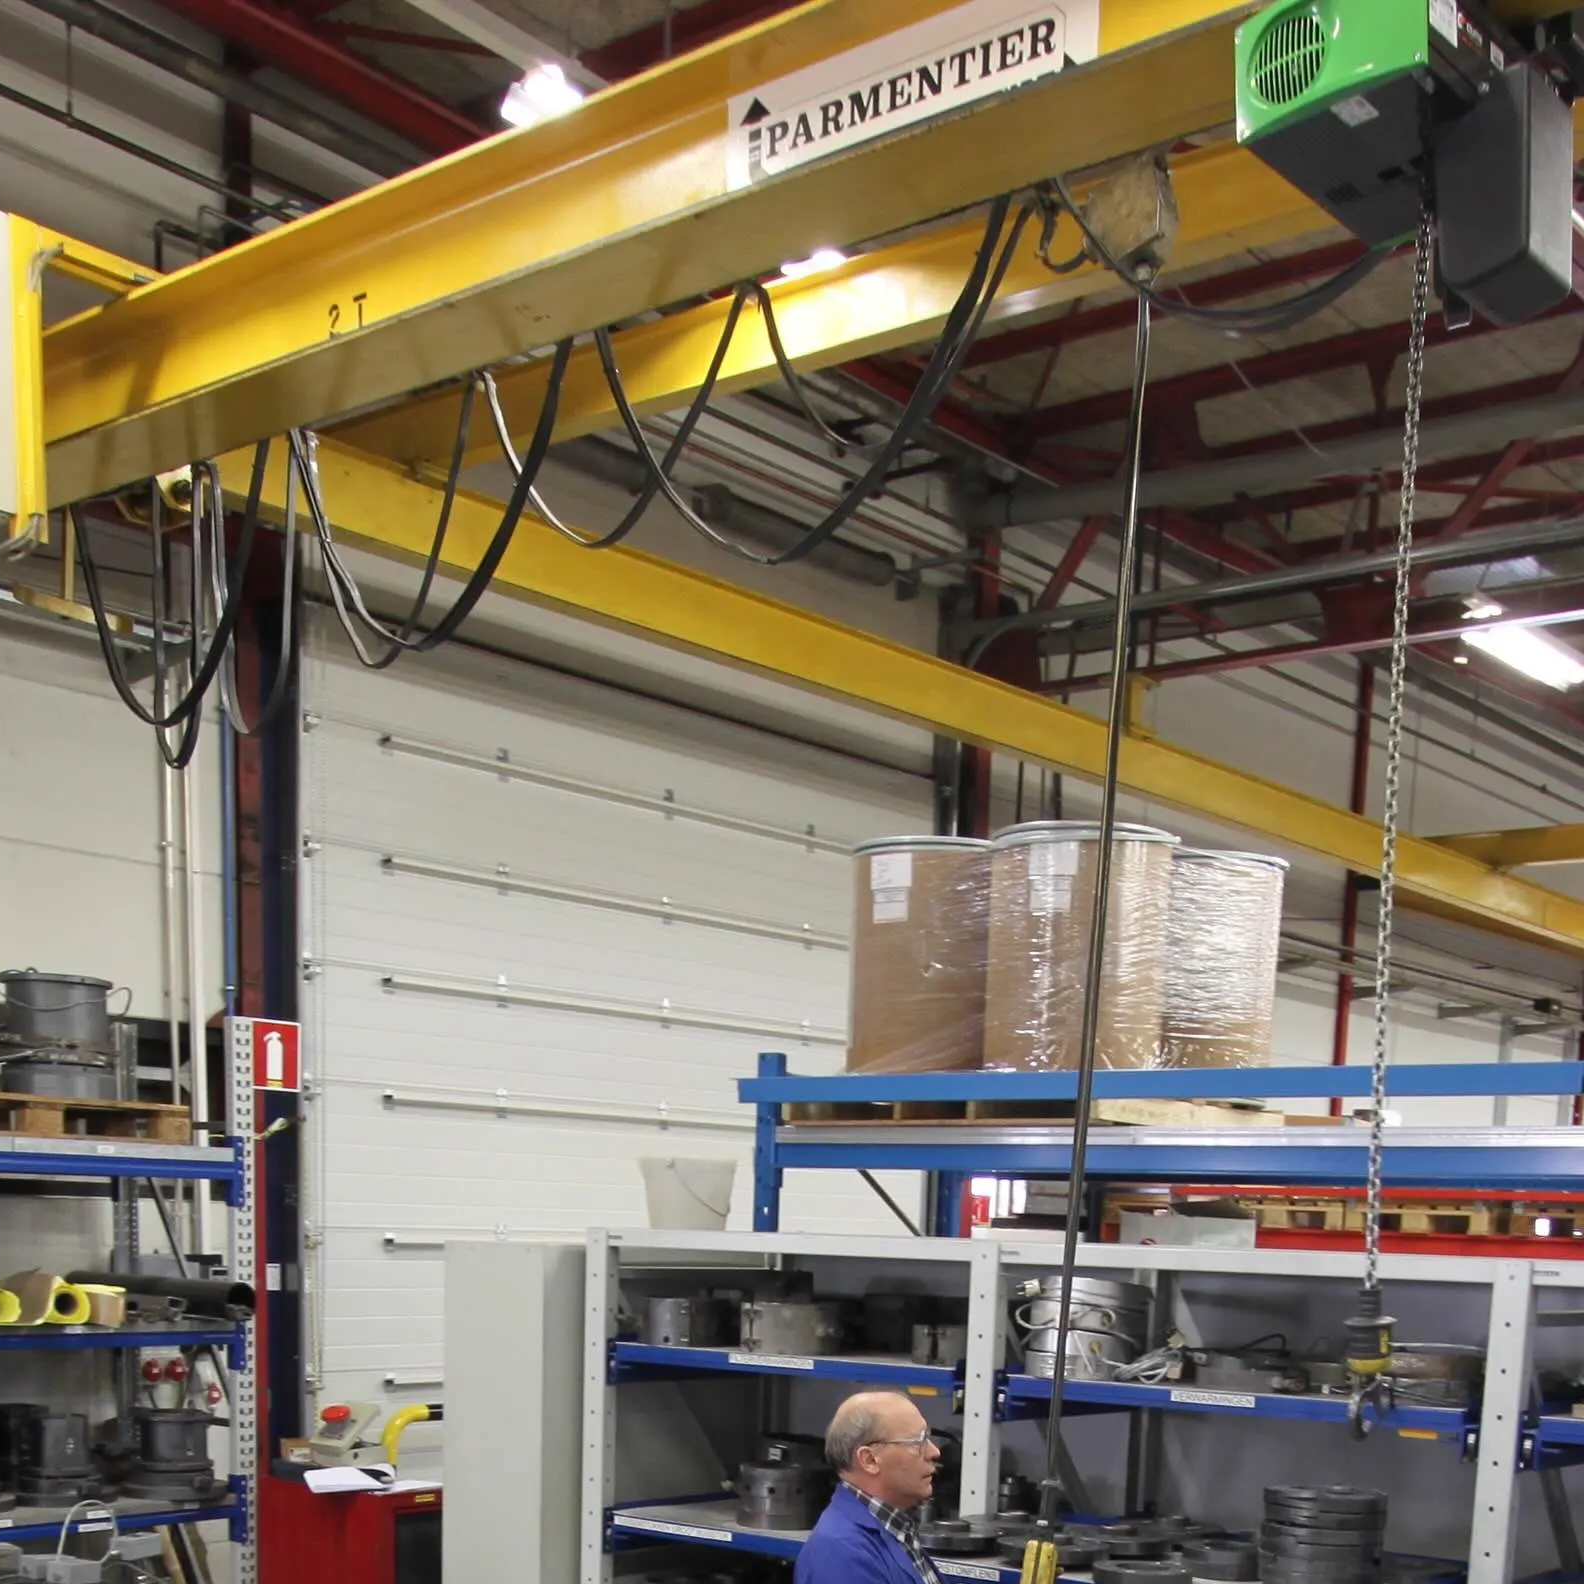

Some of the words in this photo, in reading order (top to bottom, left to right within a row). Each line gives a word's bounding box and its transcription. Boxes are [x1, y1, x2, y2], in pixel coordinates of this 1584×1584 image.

[766, 17, 1057, 159] PARMENTIER
[352, 292, 368, 328] T
[1173, 1391, 1254, 1406] VERWARMINGEN
